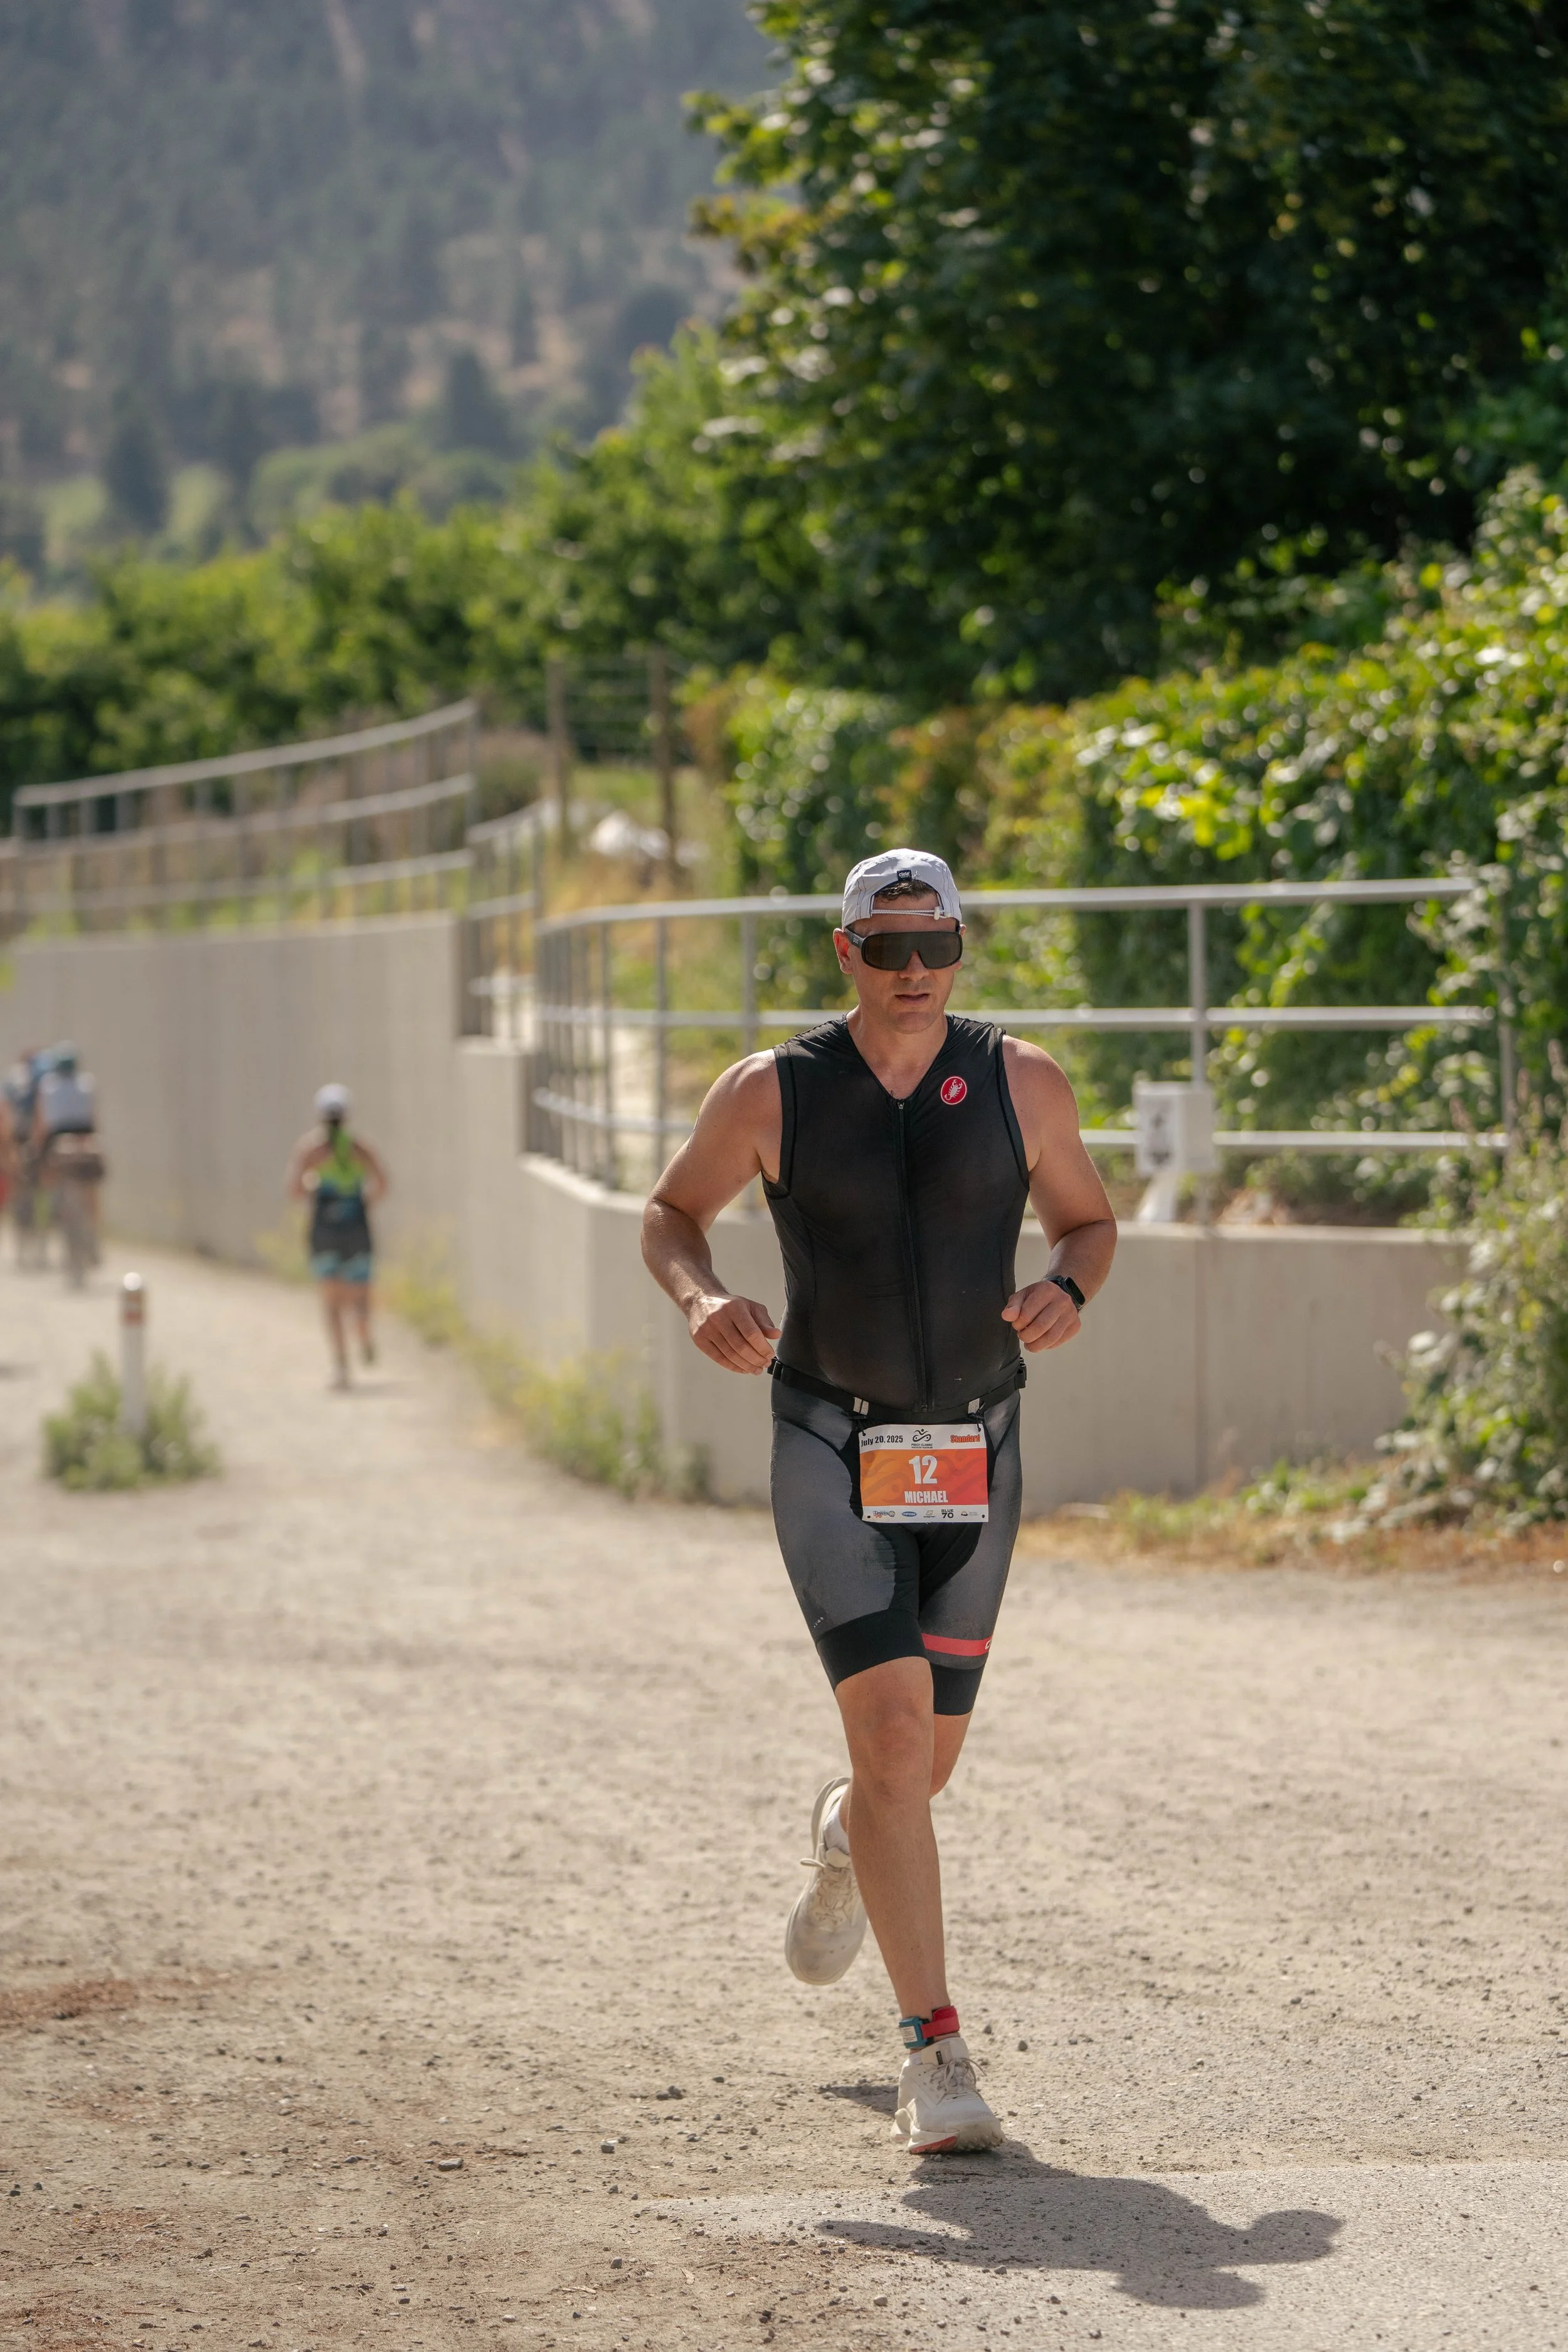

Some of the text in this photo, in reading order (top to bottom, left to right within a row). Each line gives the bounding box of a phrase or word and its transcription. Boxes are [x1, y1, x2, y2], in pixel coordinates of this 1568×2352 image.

[861, 1435, 903, 1447] July 20, 2025
[950, 1434, 980, 1443] Standard
[908, 1455, 938, 1484] 12
[904, 1490, 948, 1503] MICHAEL
